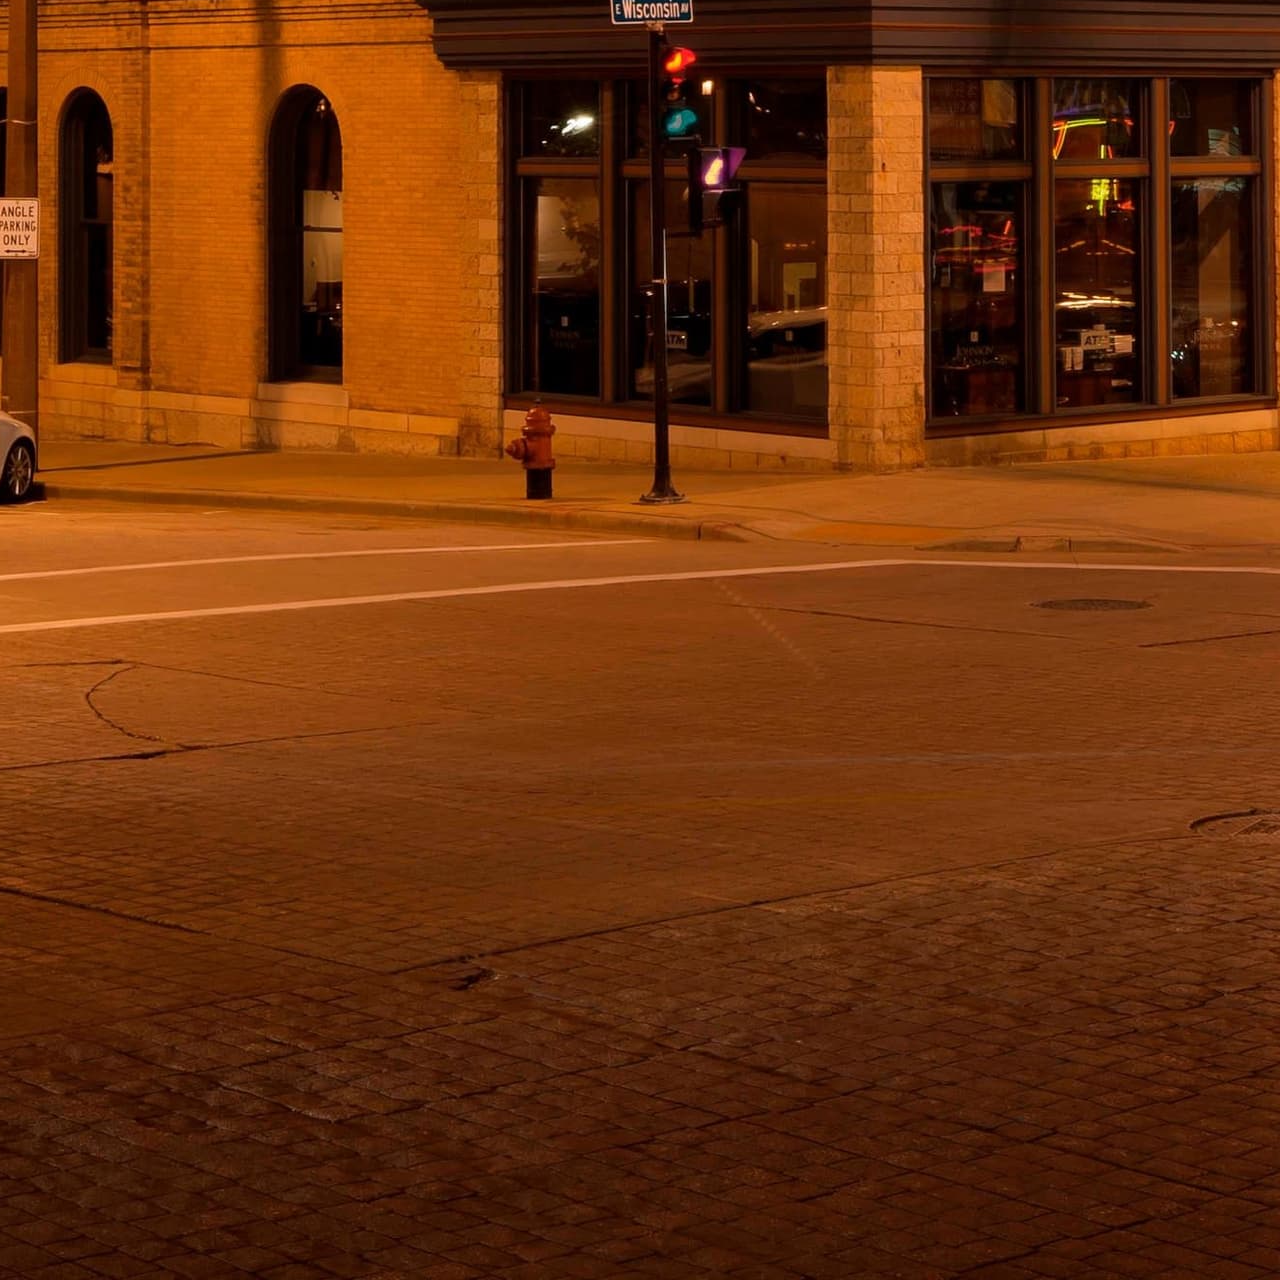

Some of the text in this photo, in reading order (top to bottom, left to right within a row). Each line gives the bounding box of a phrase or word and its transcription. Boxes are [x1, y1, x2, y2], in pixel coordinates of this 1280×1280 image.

[615, 3, 622, 15] E
[1, 206, 35, 218] ANGLE
[0, 221, 37, 232] PARKING
[3, 235, 31, 246] ONLY
